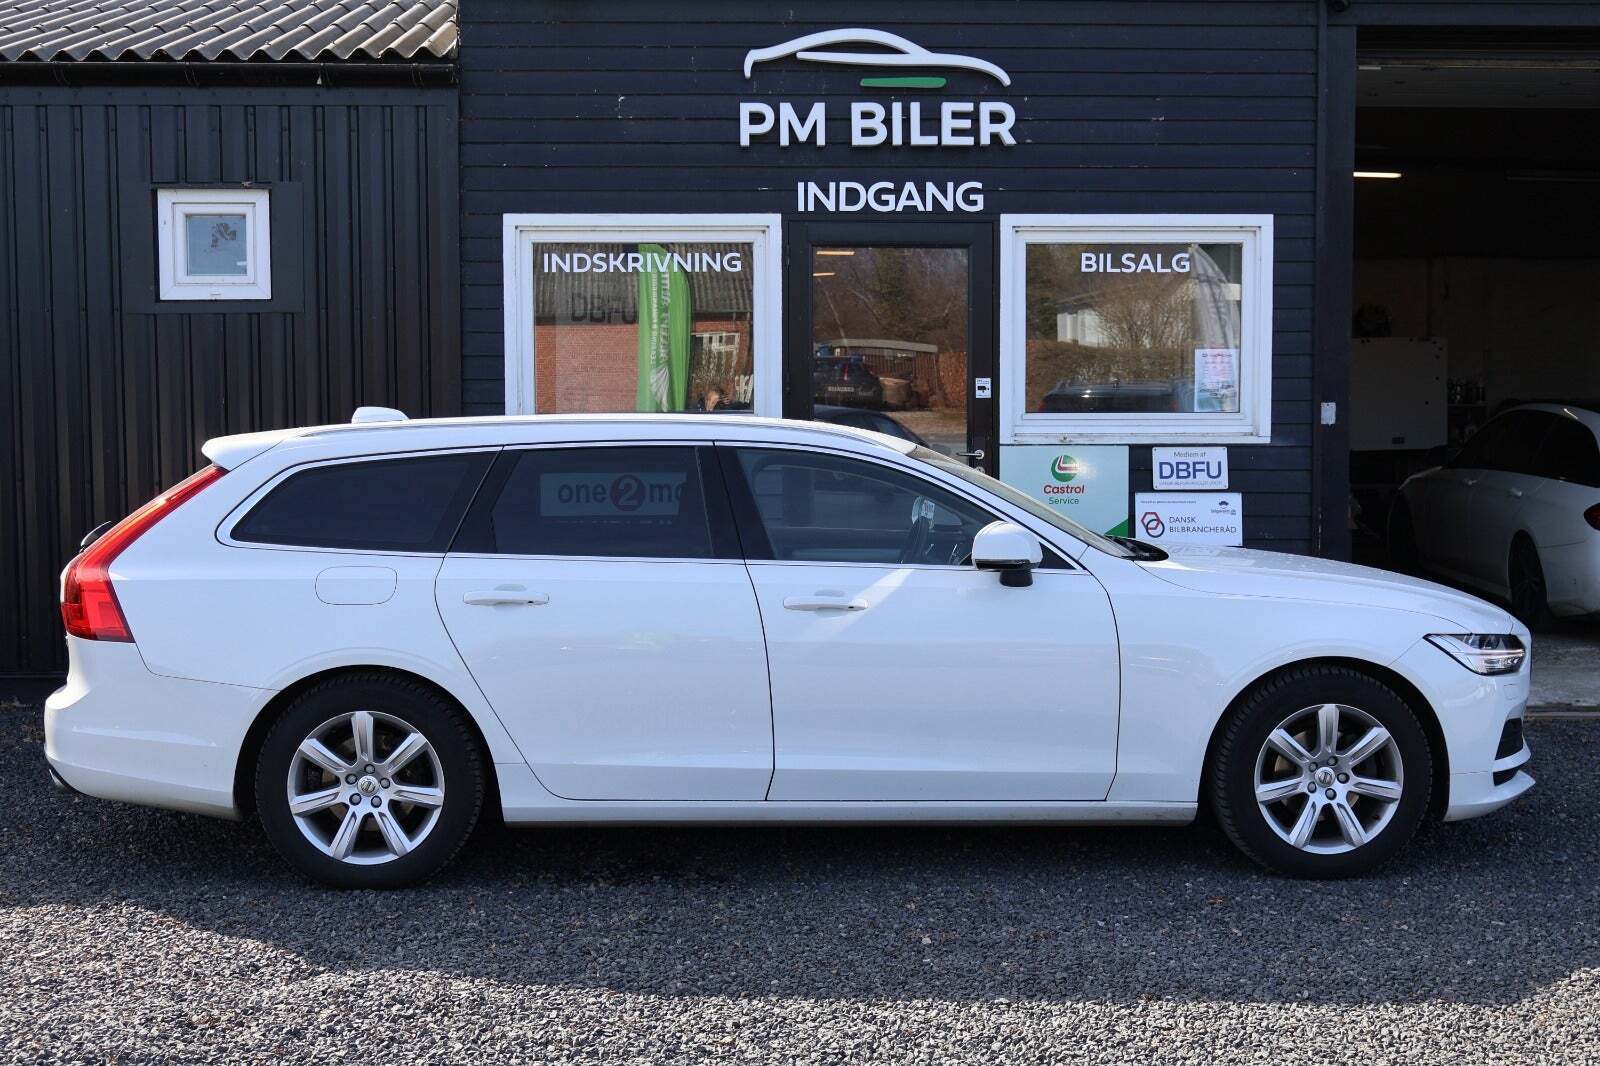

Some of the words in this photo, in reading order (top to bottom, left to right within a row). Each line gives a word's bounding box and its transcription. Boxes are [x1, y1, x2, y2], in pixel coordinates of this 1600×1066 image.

[740, 101, 826, 147] PM
[851, 101, 1017, 147] BILER
[797, 181, 984, 212] INDGANG
[543, 252, 742, 273] INDSKRIVNING
[1080, 252, 1191, 273] BILSALG
[1158, 461, 1222, 480] DBFU
[1043, 484, 1085, 494] Castrol
[1048, 496, 1080, 505] Service
[1169, 516, 1197, 524] DANSK
[1169, 525, 1237, 534] BILBRANCHERÅD
